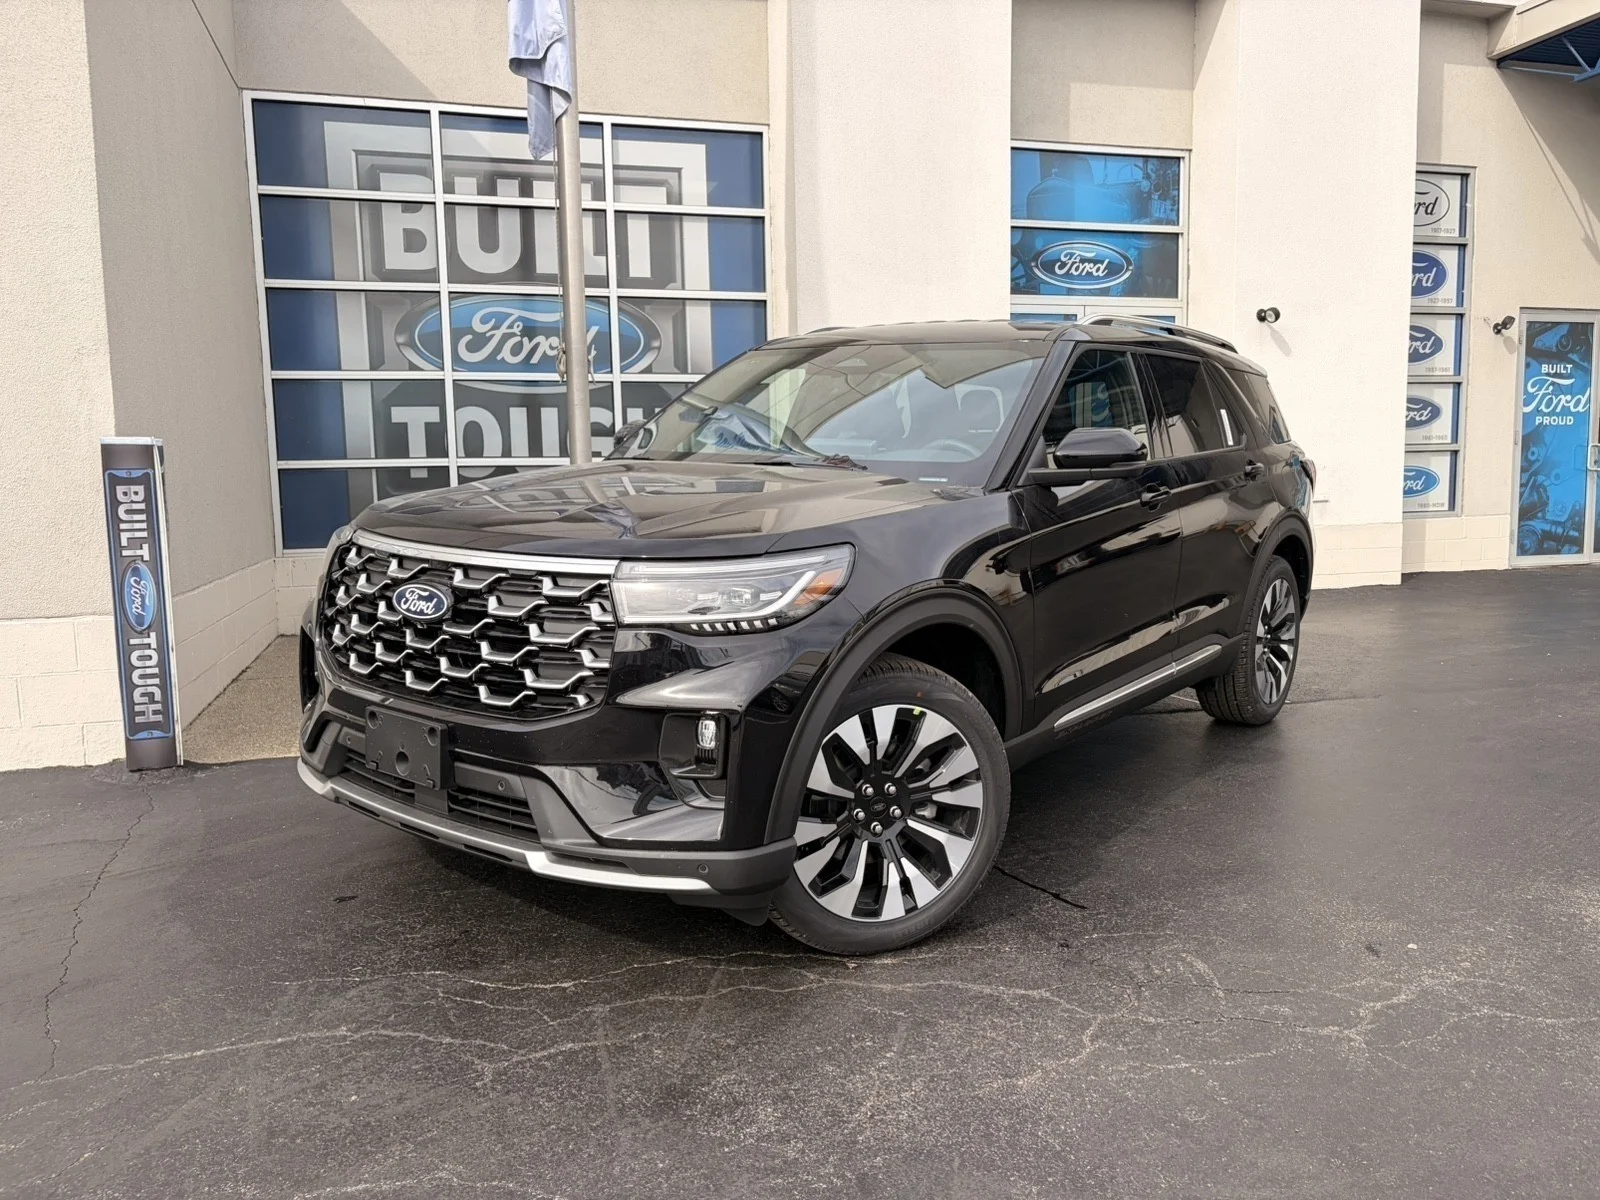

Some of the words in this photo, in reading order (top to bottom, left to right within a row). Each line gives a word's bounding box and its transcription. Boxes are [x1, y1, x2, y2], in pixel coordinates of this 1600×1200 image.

[1414, 191, 1439, 216] rd
[379, 172, 666, 278] BUILT
[1055, 249, 1109, 277] Ford
[1411, 262, 1437, 287] rd
[1409, 330, 1435, 354] rd
[1541, 364, 1573, 373] BUILT
[1522, 376, 1591, 413] Ford
[1406, 403, 1432, 421] rd
[1535, 416, 1574, 425] PROUD
[391, 405, 661, 478] TOU
[1404, 471, 1426, 491] rd
[116, 485, 150, 561] BUILT
[130, 577, 150, 616] Ford
[401, 588, 437, 614] Ford
[129, 631, 163, 723] TOUGH
